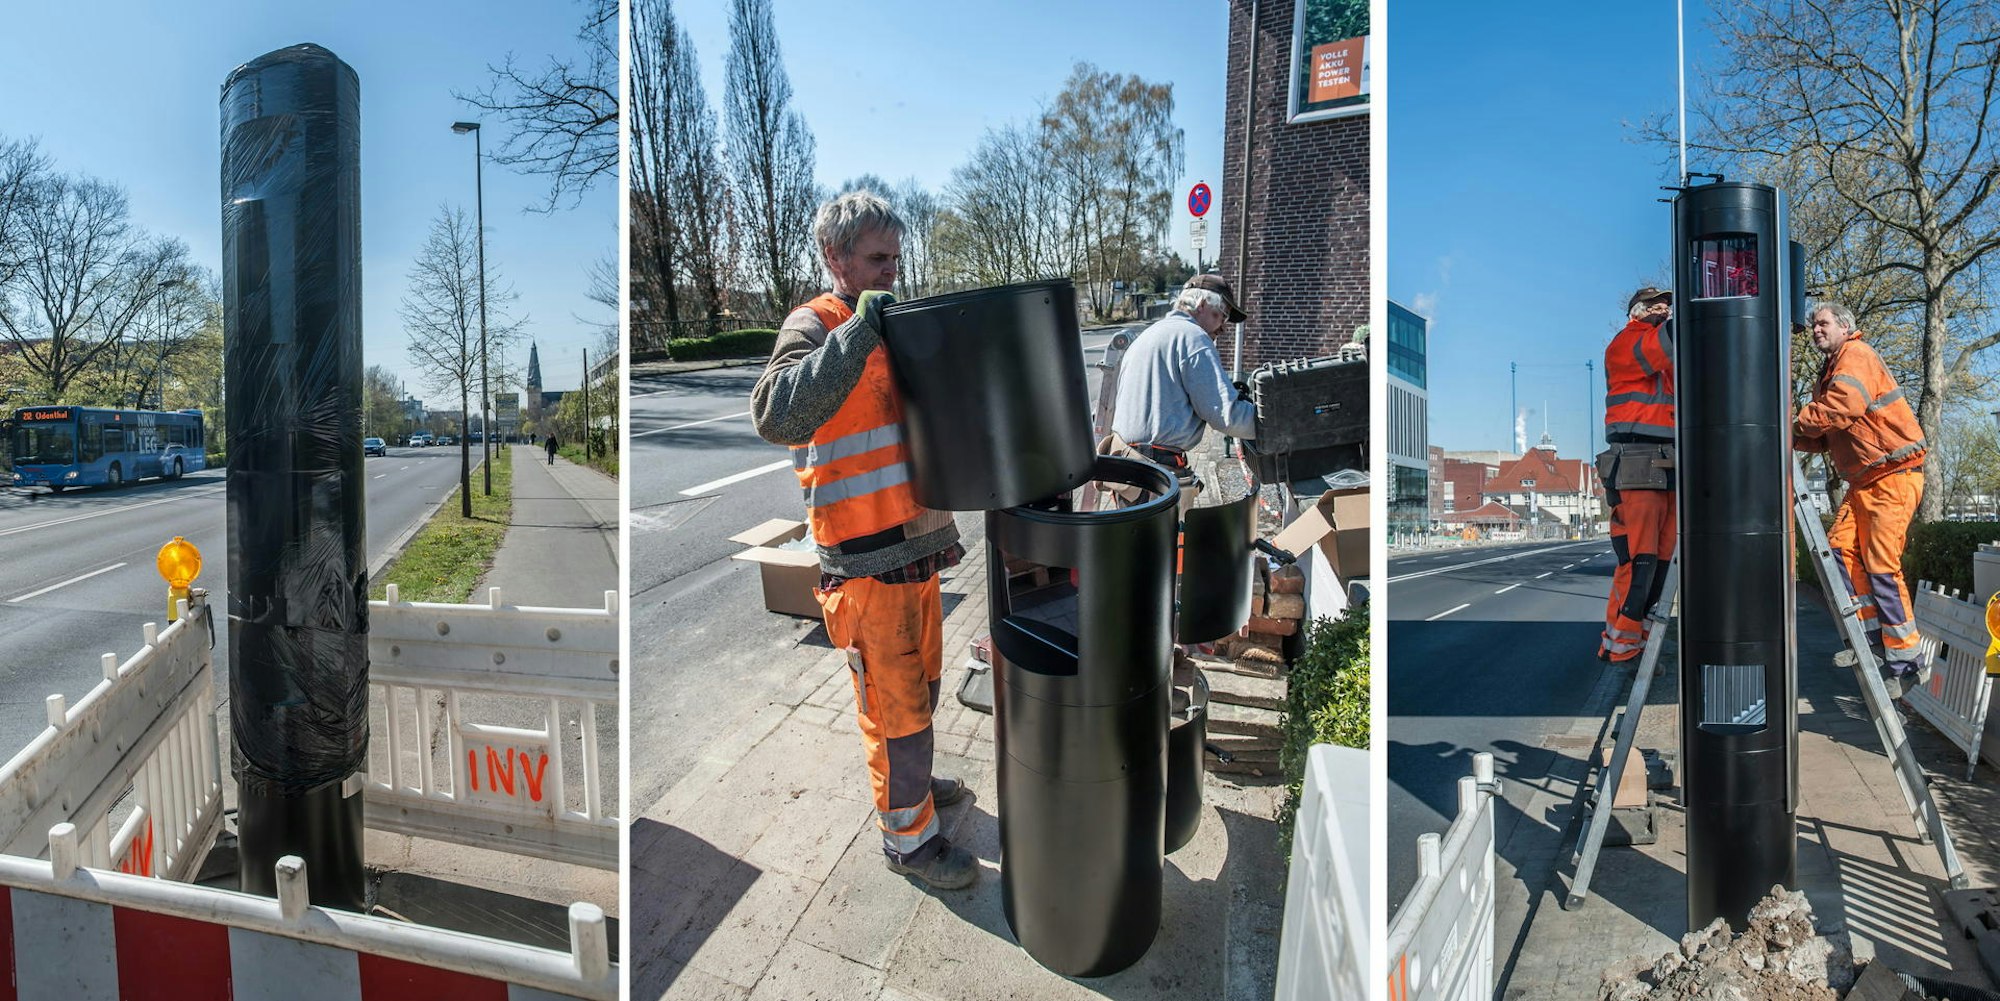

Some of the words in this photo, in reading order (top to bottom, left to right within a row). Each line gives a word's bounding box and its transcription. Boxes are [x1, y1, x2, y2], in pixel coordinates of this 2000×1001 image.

[1320, 49, 1348, 60] VOLLE
[1319, 60, 1344, 70] AKKU
[1318, 67, 1350, 79] POWER
[1318, 76, 1350, 87] TESTEN
[137, 413, 156, 428] NRW
[139, 436, 158, 454] LEG
[468, 744, 549, 802] INV
